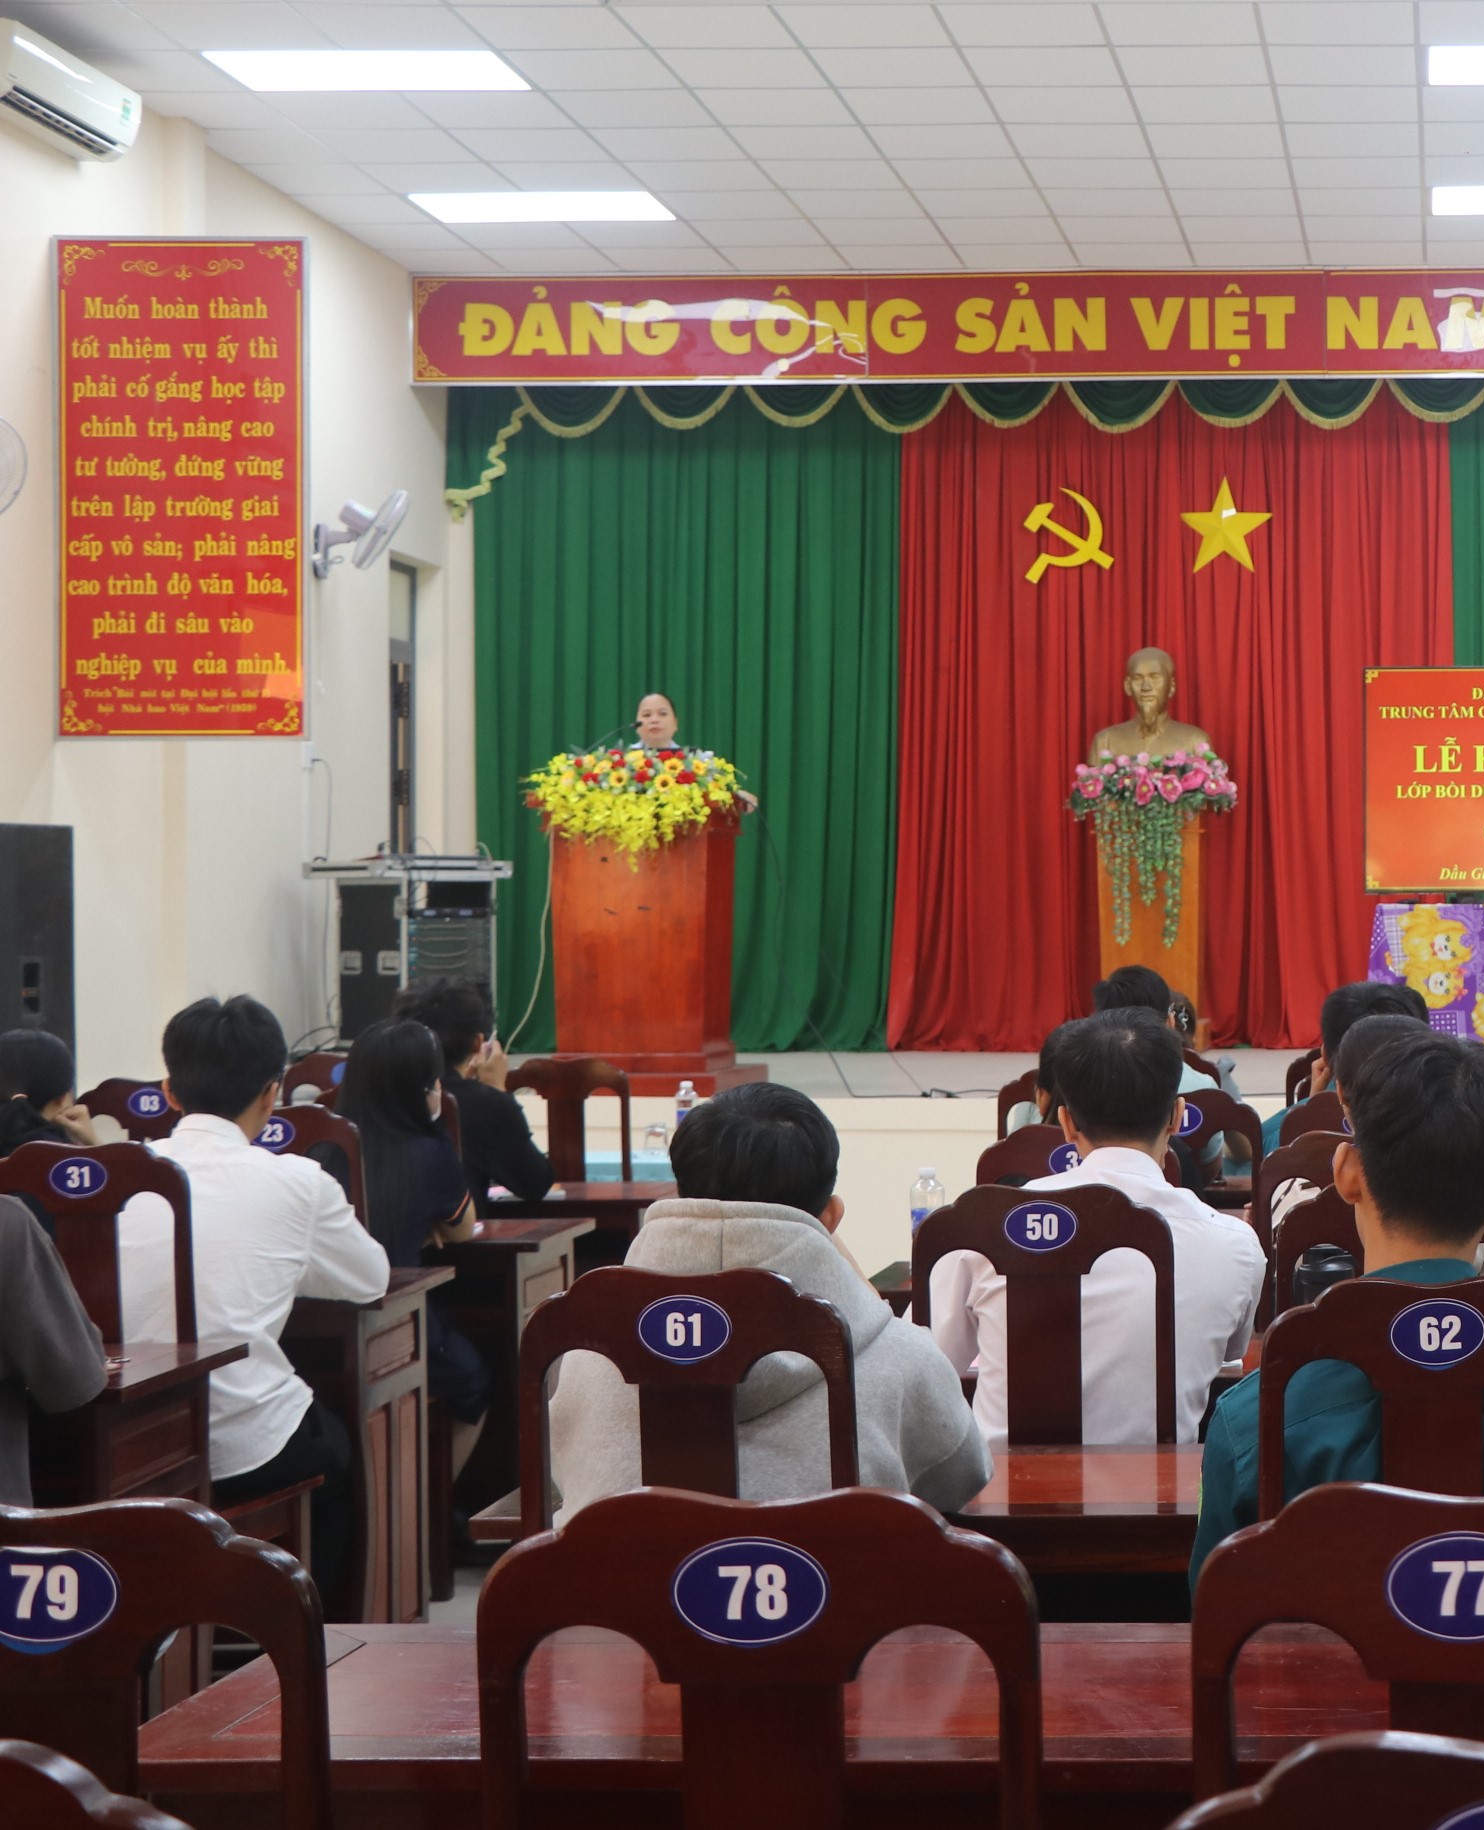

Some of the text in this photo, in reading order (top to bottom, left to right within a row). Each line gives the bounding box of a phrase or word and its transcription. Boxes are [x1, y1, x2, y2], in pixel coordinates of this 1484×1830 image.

[84, 295, 268, 319] Muốn hoàn thành
[458, 285, 680, 356] ĐẢNG
[709, 285, 927, 354] CÔNG
[954, 282, 1107, 354] SẢN
[1131, 283, 1295, 367] VIỆT
[109, 336, 278, 364] nhiệm vụ thì
[73, 375, 285, 404] phải học tập
[80, 415, 275, 442] chính nâng cao
[71, 495, 279, 522] trên lập giai
[111, 531, 298, 562] vô phải nâng
[65, 572, 234, 599] cao trình độ văn
[93, 611, 255, 639] phải đi sâu vào
[76, 652, 228, 681] nghiệp vụ của
[1379, 706, 1434, 718] TRUNG
[1438, 703, 1474, 718] TÂM
[1414, 737, 1462, 772] LỄ
[1397, 782, 1431, 798] LỚP
[1440, 865, 1467, 880] Dầu
[140, 1095, 159, 1111] 03
[261, 1123, 284, 1142] 23
[67, 1166, 90, 1188] 31
[1026, 1214, 1058, 1240] 50
[666, 1312, 701, 1346] 61
[1420, 1315, 1462, 1351] 62
[11, 1565, 78, 1620] 79
[718, 1564, 787, 1620] 78
